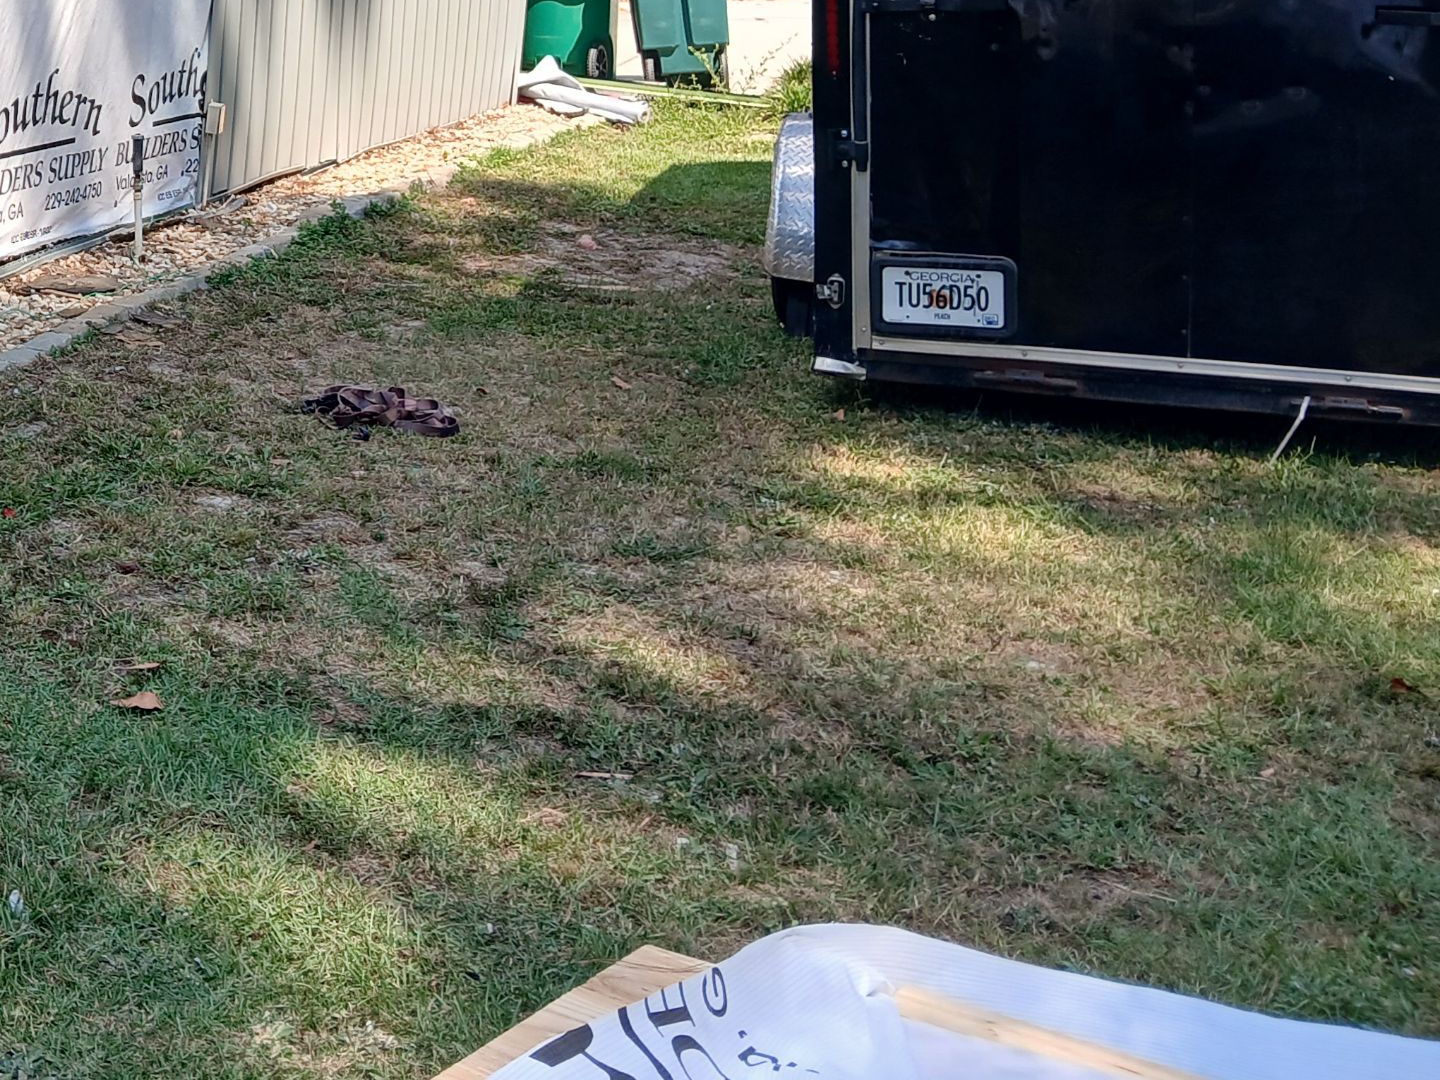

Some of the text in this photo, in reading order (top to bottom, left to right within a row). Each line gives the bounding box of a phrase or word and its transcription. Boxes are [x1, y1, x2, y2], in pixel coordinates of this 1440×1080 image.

[115, 127, 187, 167] BULDERS
[47, 147, 108, 185] SUPPLY
[156, 164, 169, 183] GA
[8, 201, 24, 221] GA
[44, 180, 101, 211] 229-242-4750
[909, 271, 974, 283] GEORGIA
[894, 281, 990, 312] TU56D50
